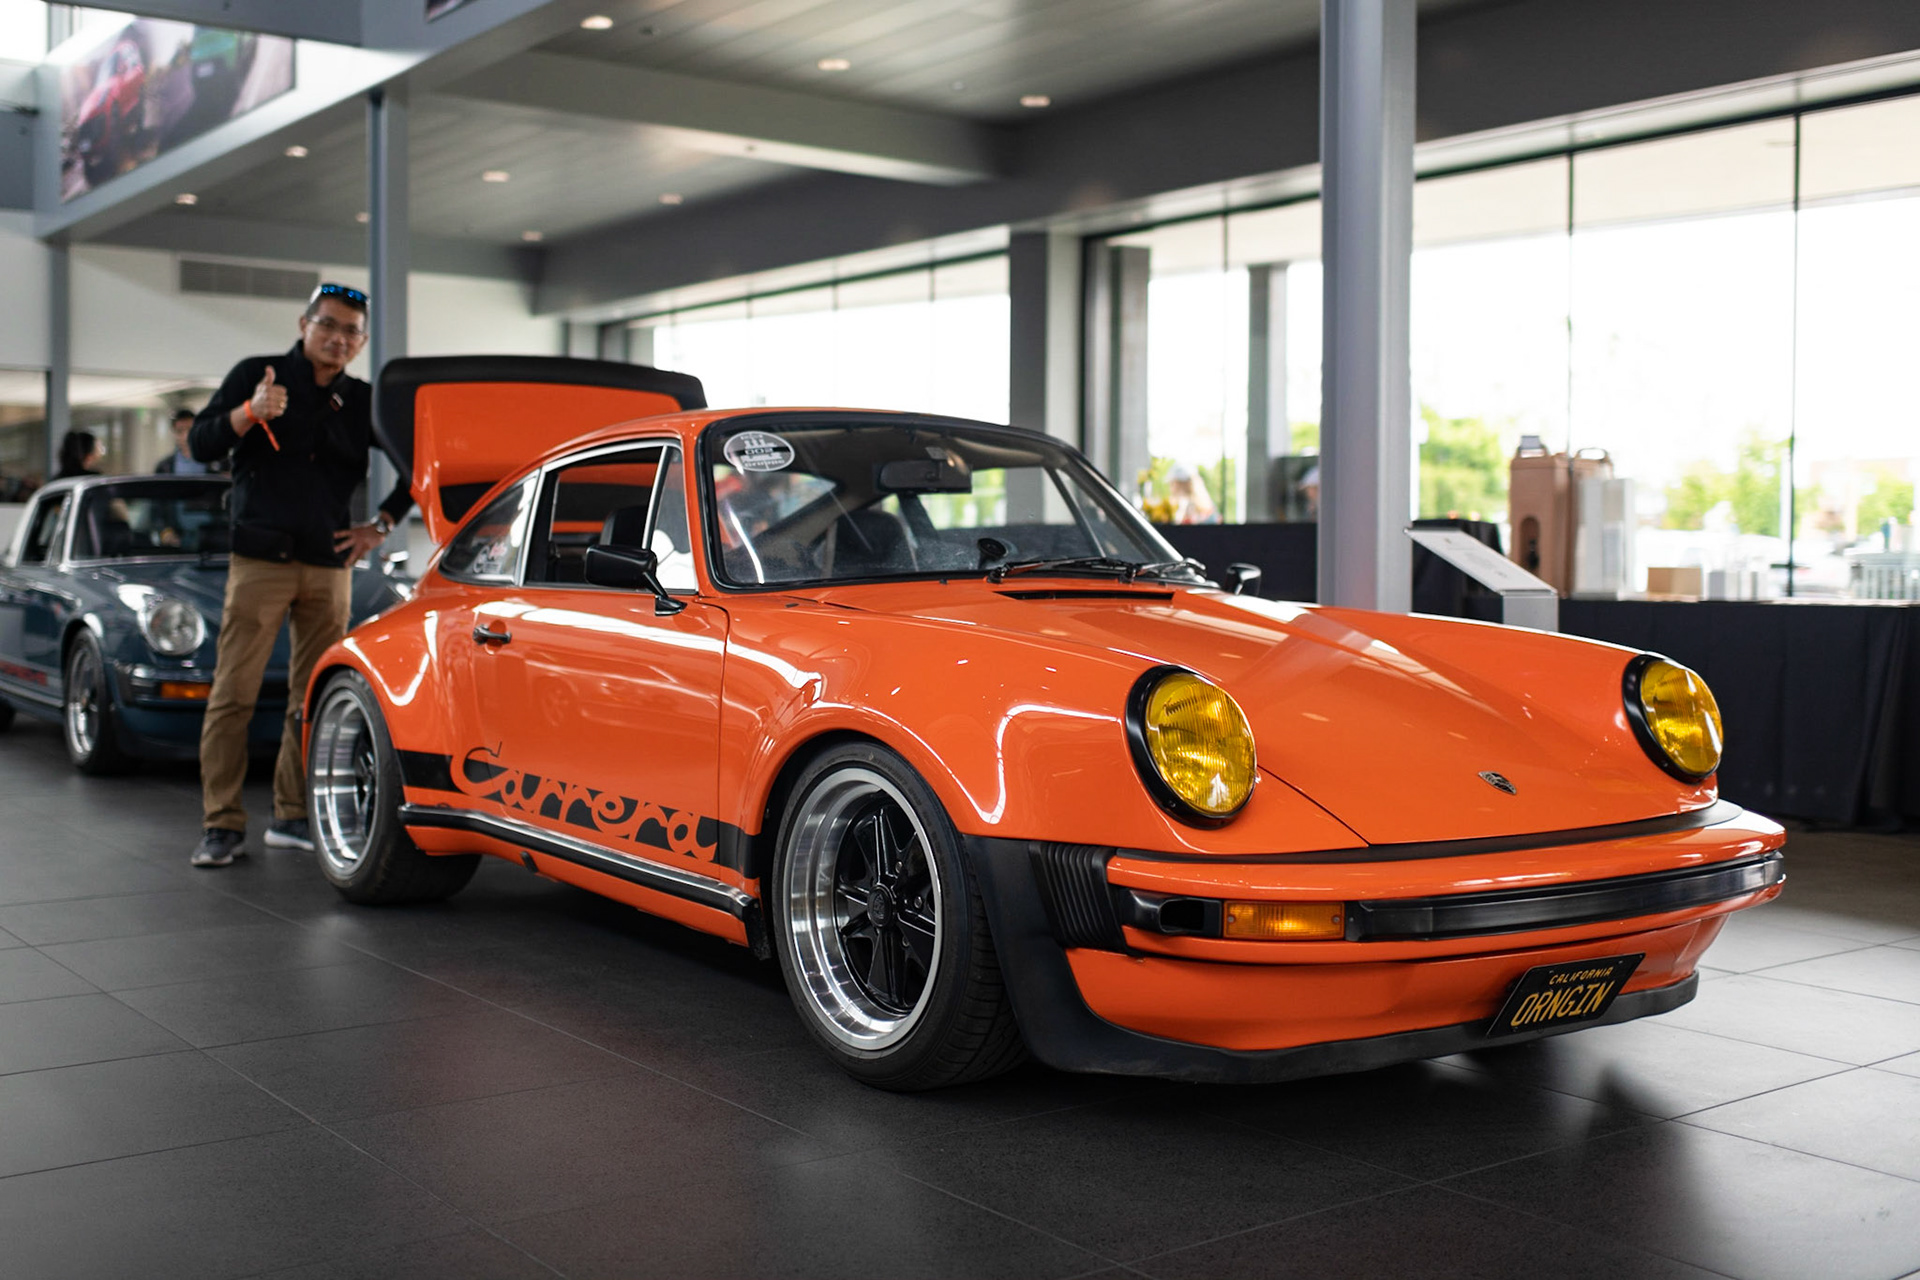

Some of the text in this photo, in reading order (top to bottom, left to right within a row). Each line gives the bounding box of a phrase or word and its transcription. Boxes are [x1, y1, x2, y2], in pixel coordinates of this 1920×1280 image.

[450, 742, 718, 862] Carrera
[1549, 966, 1614, 985] CALIFORNIA
[1510, 980, 1615, 1026] ORNGIN
